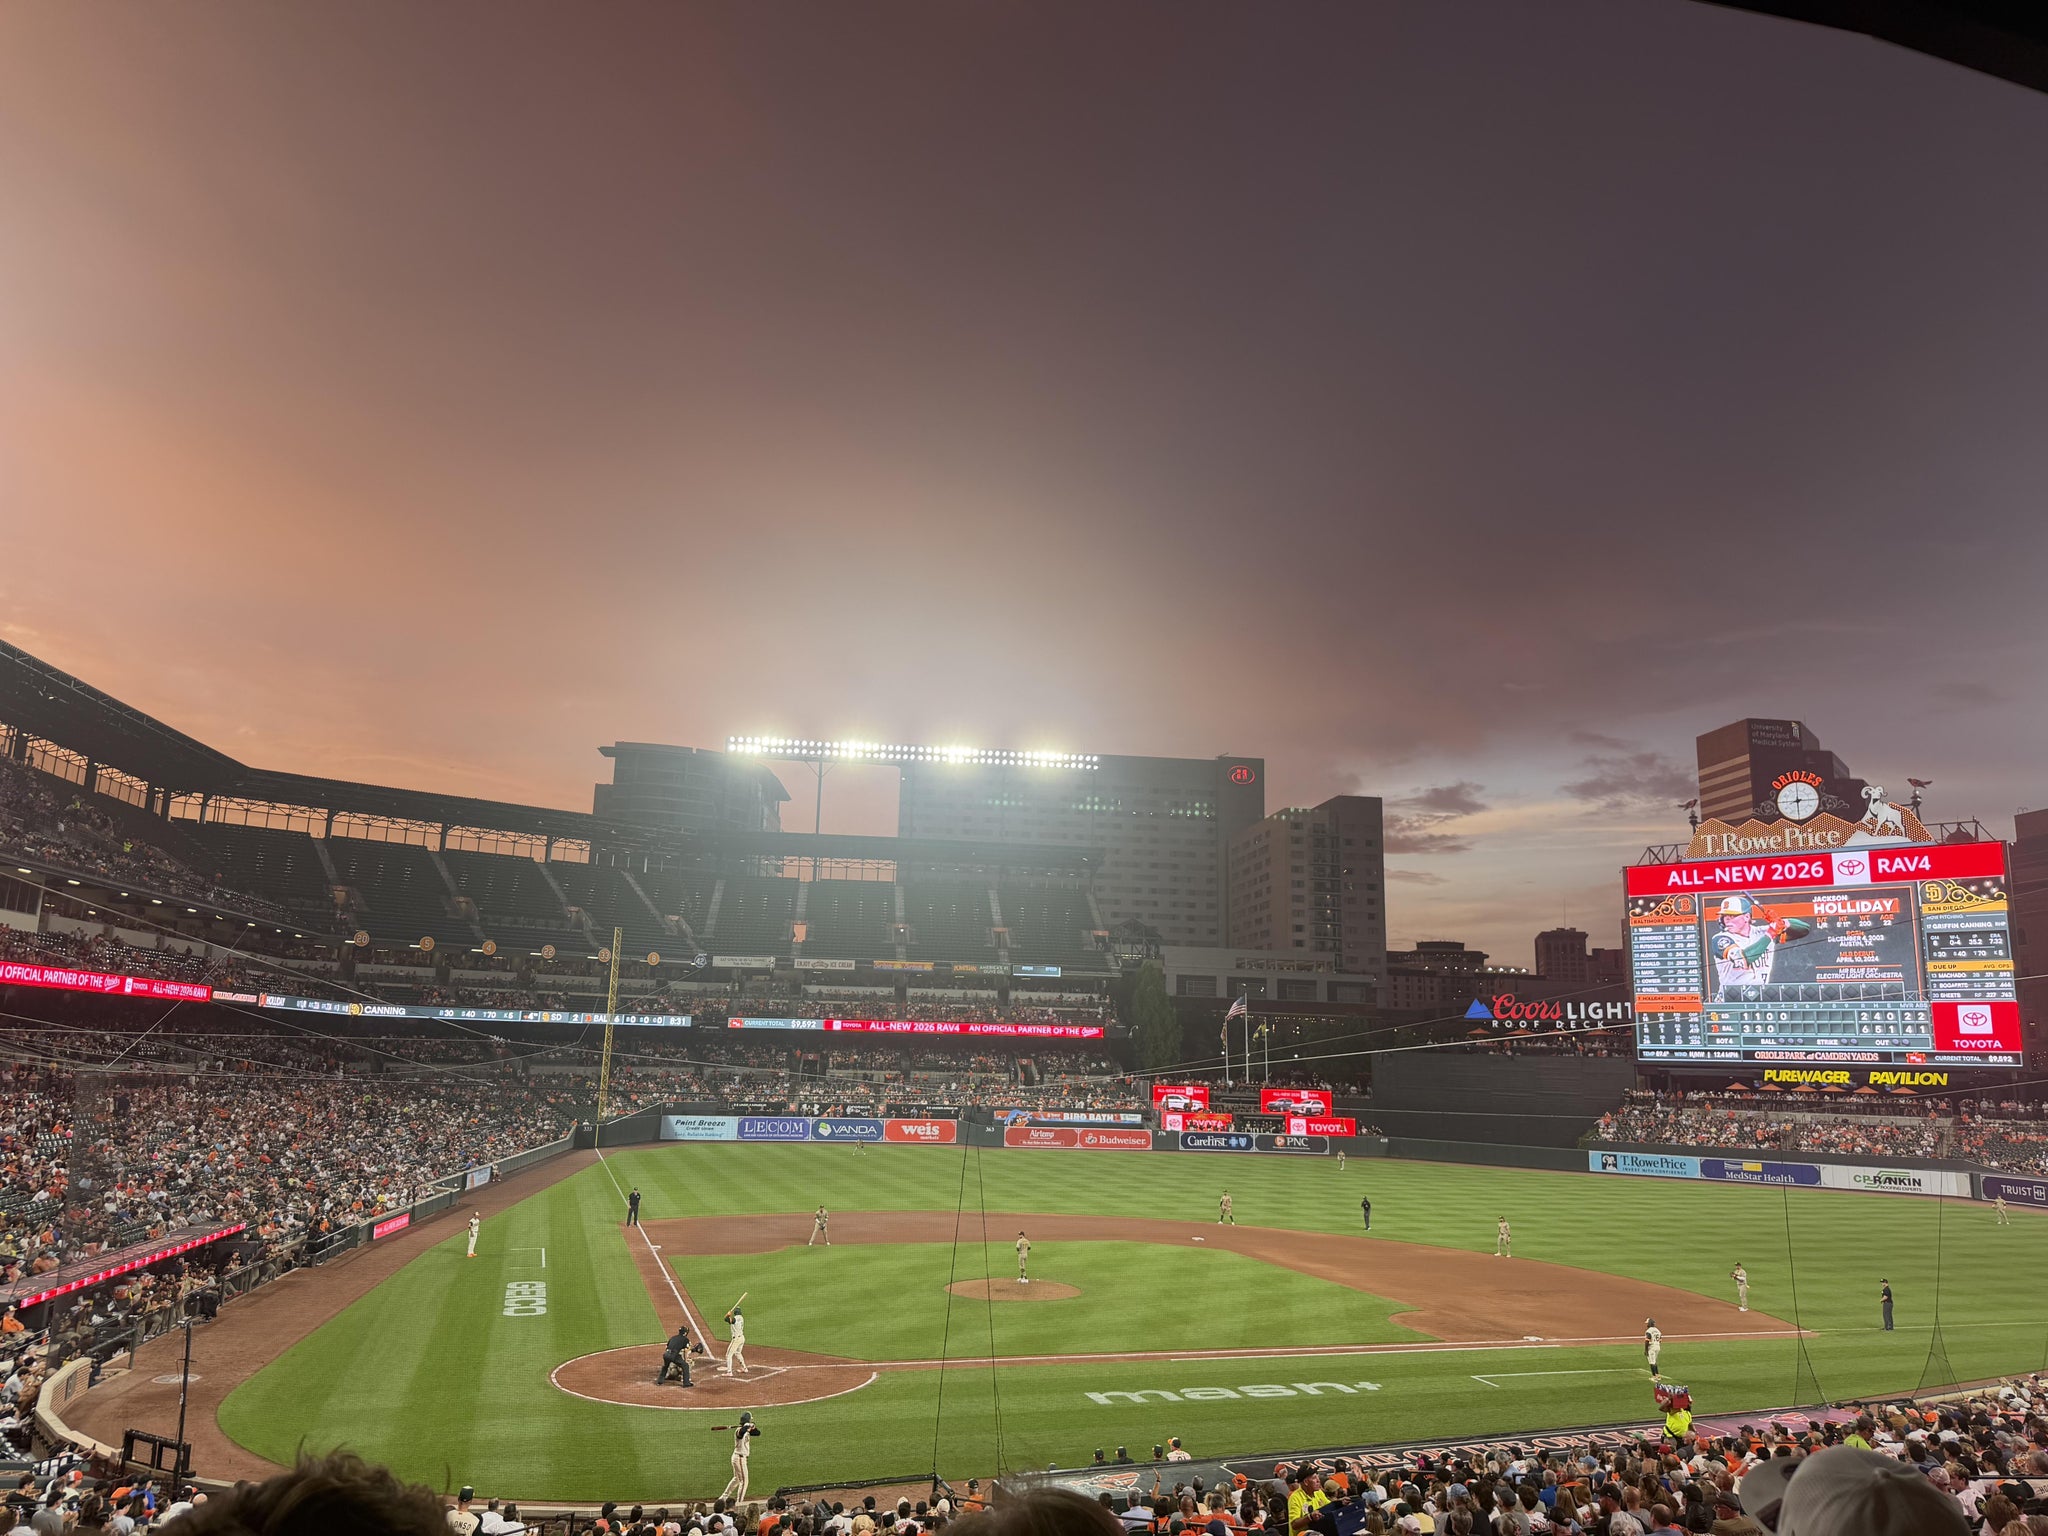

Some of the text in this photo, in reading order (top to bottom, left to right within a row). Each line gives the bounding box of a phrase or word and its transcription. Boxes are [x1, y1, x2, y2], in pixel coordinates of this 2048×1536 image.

[1751, 723, 1783, 732] University
[1760, 731, 1790, 740] Maryland
[1771, 770, 1823, 790] ORIOLES
[1700, 827, 1841, 854] T. Rowe Price
[1667, 855, 1932, 887] ALL-NEW 2026 RAV4
[1812, 895, 1848, 903] JACKSON
[1813, 900, 1893, 915] HOLLIDAY
[4, 965, 41, 981] OFFICIAL
[43, 969, 77, 985] PARTNER
[78, 974, 90, 986] OF
[90, 974, 103, 988] THE
[193, 987, 207, 998] RAV4
[1492, 993, 1563, 1020] Coors
[364, 1005, 406, 1015] CANNING
[444, 1009, 454, 1017] 30
[551, 1013, 562, 1021] SD
[1766, 1012, 1774, 1020] 0
[1780, 1012, 1787, 1020] 0
[1860, 1012, 1868, 1020] 2
[1874, 1012, 1881, 1020] 4
[1886, 1012, 1894, 1020] 0
[1904, 1012, 1911, 1020] 2
[1917, 1012, 1925, 1020] 2
[869, 1021, 911, 1031] ALL-NEW
[914, 1022, 935, 1031] 2026
[936, 1023, 960, 1032] RAV4
[968, 1024, 981, 1032] AN
[982, 1025, 1016, 1033] OFFICIAL
[1018, 1026, 1052, 1034] PARTNER
[1492, 1020, 1605, 1029] ROOF DECK
[1862, 1025, 1869, 1033] 6
[1875, 1025, 1882, 1033] 5
[1905, 1025, 1912, 1033] 4
[1952, 1039, 2003, 1049] TOYOTA
[1754, 1051, 1785, 1060] ORIOLE
[1785, 1051, 1806, 1060] PARK
[1815, 1052, 1850, 1060] CAMDEN
[1850, 1052, 1879, 1060] YARDS
[1763, 1069, 1949, 1086] PUREWAGER PAVILION
[1063, 1112, 1087, 1121] BIRD
[1089, 1112, 1114, 1121] BATH
[743, 1121, 804, 1133] LECOM
[832, 1125, 877, 1135] VANDA
[901, 1122, 940, 1136] weis
[1099, 1135, 1146, 1145] Budweiser
[1287, 1137, 1308, 1147] PNC
[1621, 1155, 1687, 1170] T. Rowe Price
[1725, 1171, 1795, 1183] MedStar Health
[2001, 1184, 2032, 1197] TRUIST
